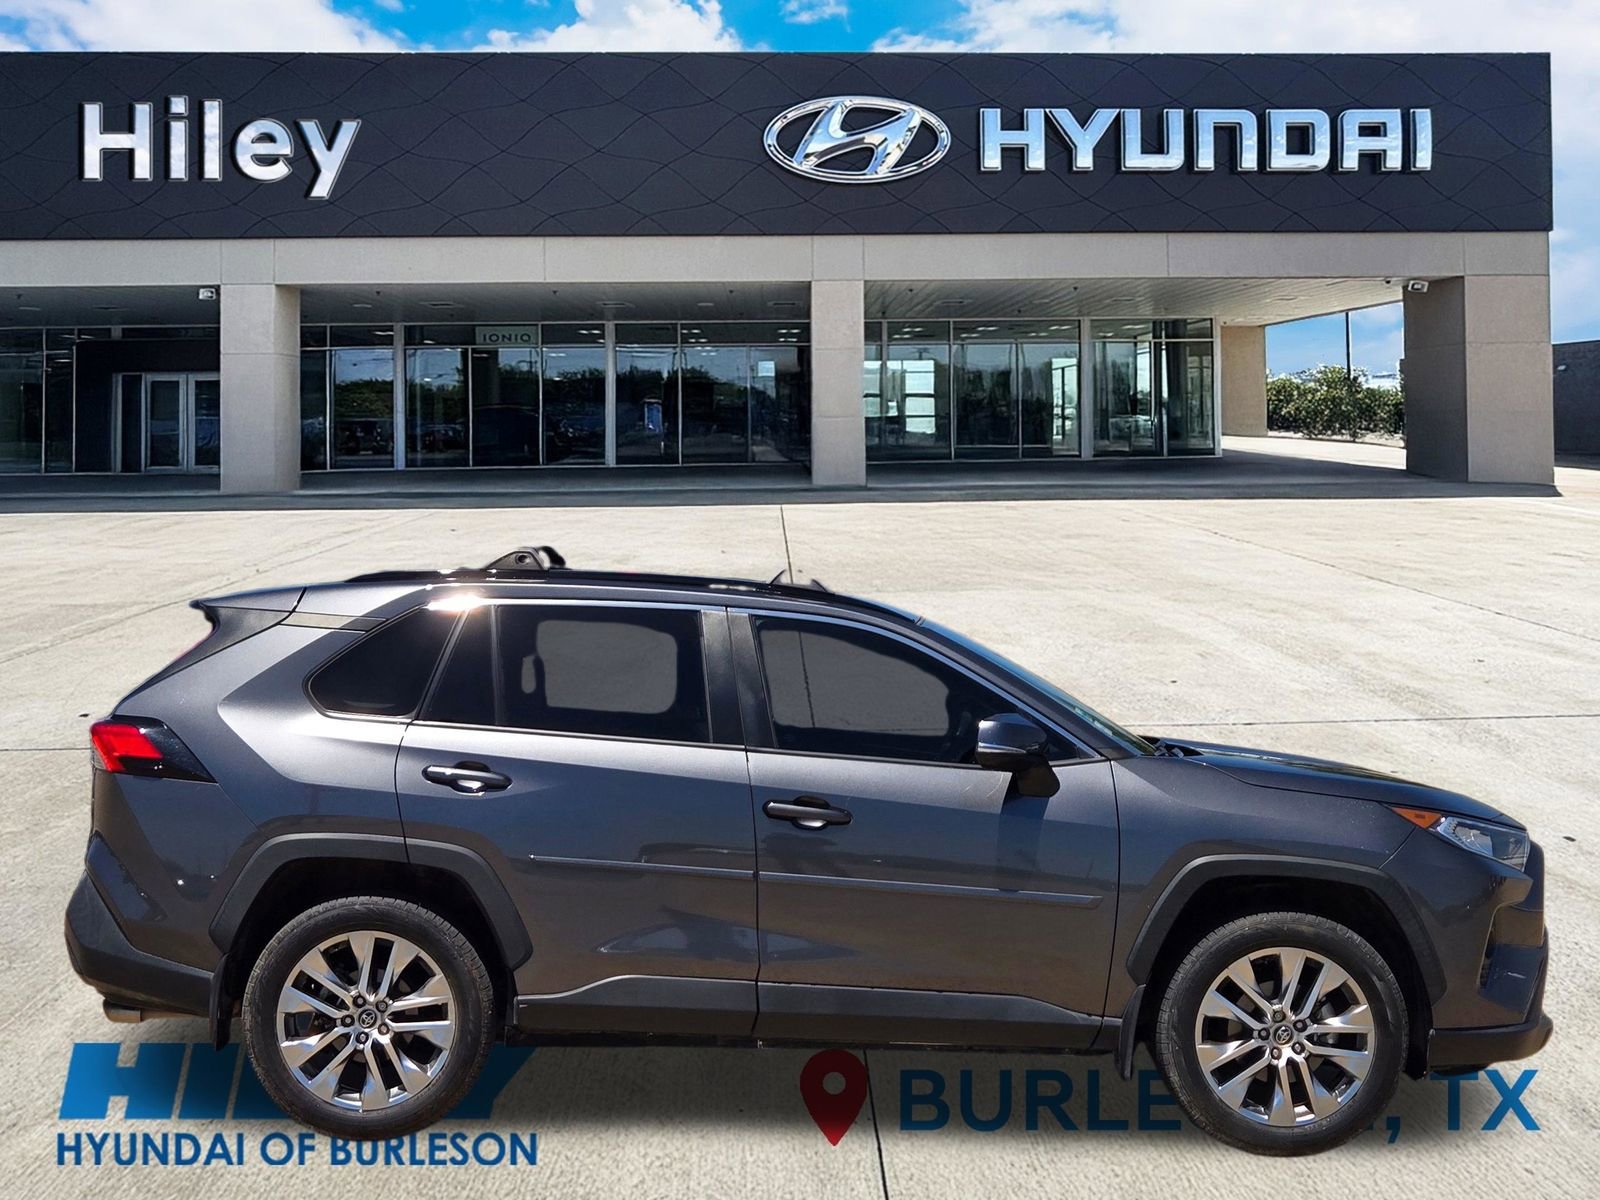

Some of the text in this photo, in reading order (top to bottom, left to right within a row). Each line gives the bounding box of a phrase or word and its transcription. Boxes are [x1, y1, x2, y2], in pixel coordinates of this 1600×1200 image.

[80, 95, 361, 199] Hiley
[979, 107, 1432, 172] HYUNDAI
[482, 333, 532, 343] IONIQ
